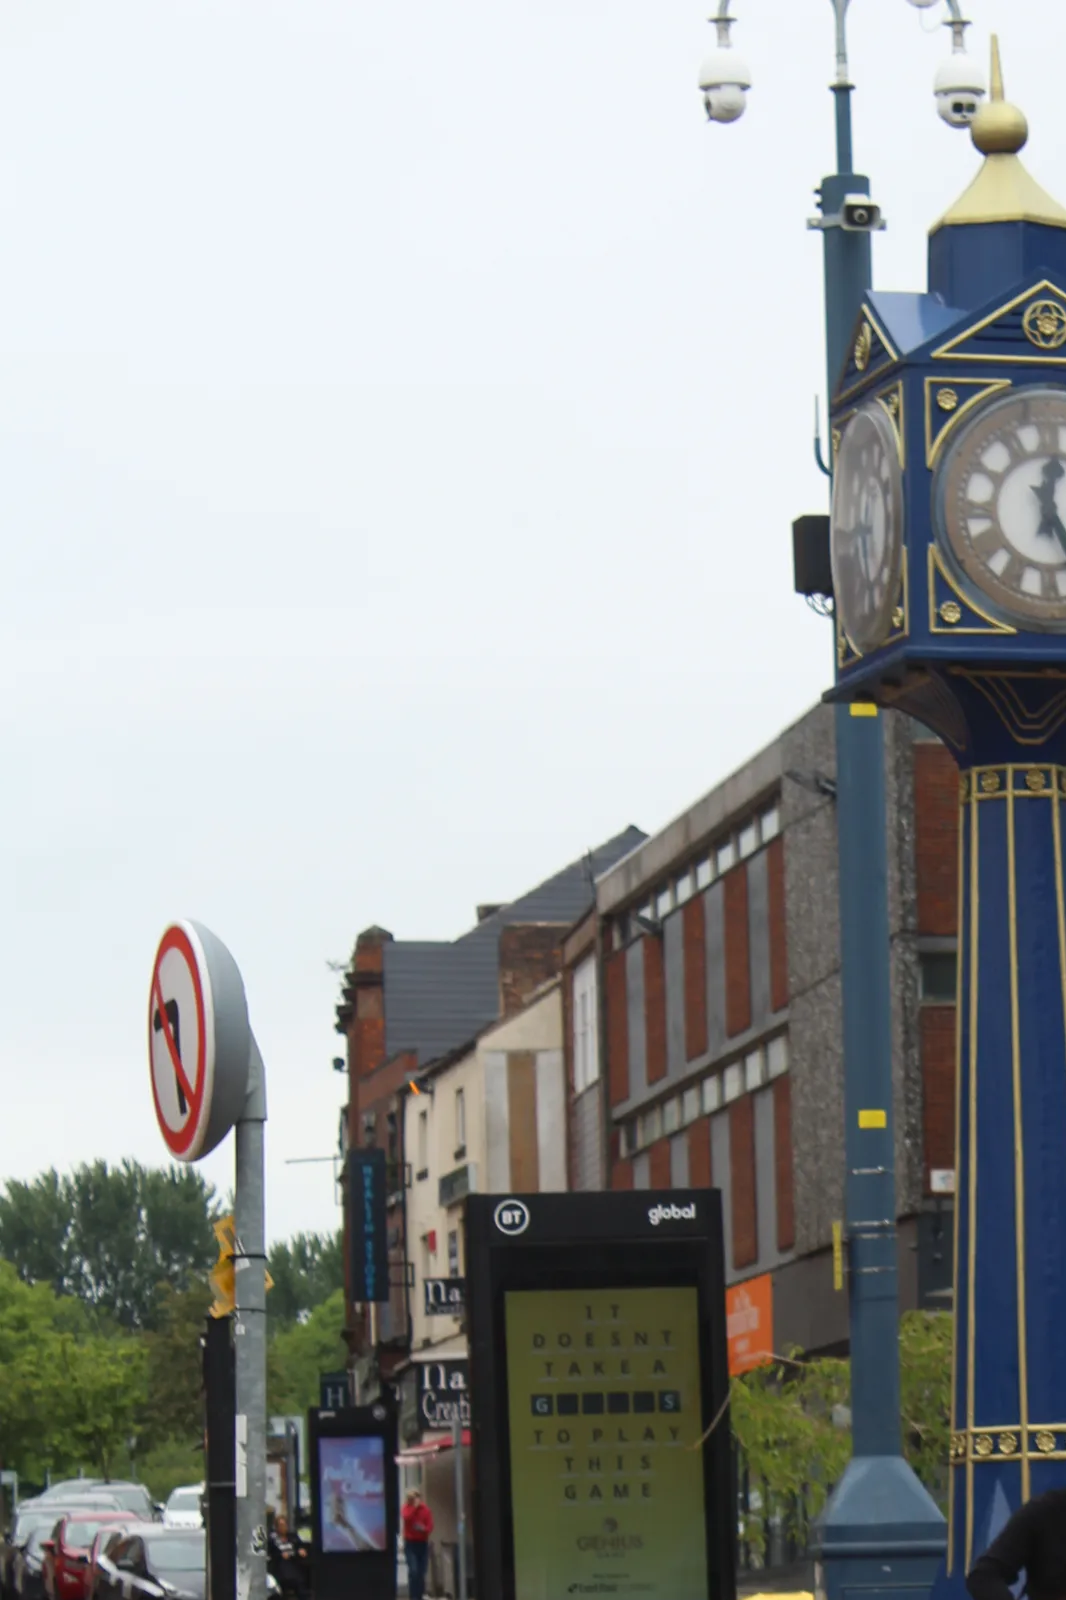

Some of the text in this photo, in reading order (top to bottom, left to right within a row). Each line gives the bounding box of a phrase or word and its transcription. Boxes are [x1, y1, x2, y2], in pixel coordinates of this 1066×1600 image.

[501, 1209, 522, 1225] BT
[647, 1202, 697, 1226] global
[532, 1329, 672, 1349] DOESNT
[545, 1359, 631, 1377] TAKE
[533, 1426, 680, 1445] TO PLAY
[564, 1455, 651, 1472] THIS
[564, 1483, 652, 1501] GAME
